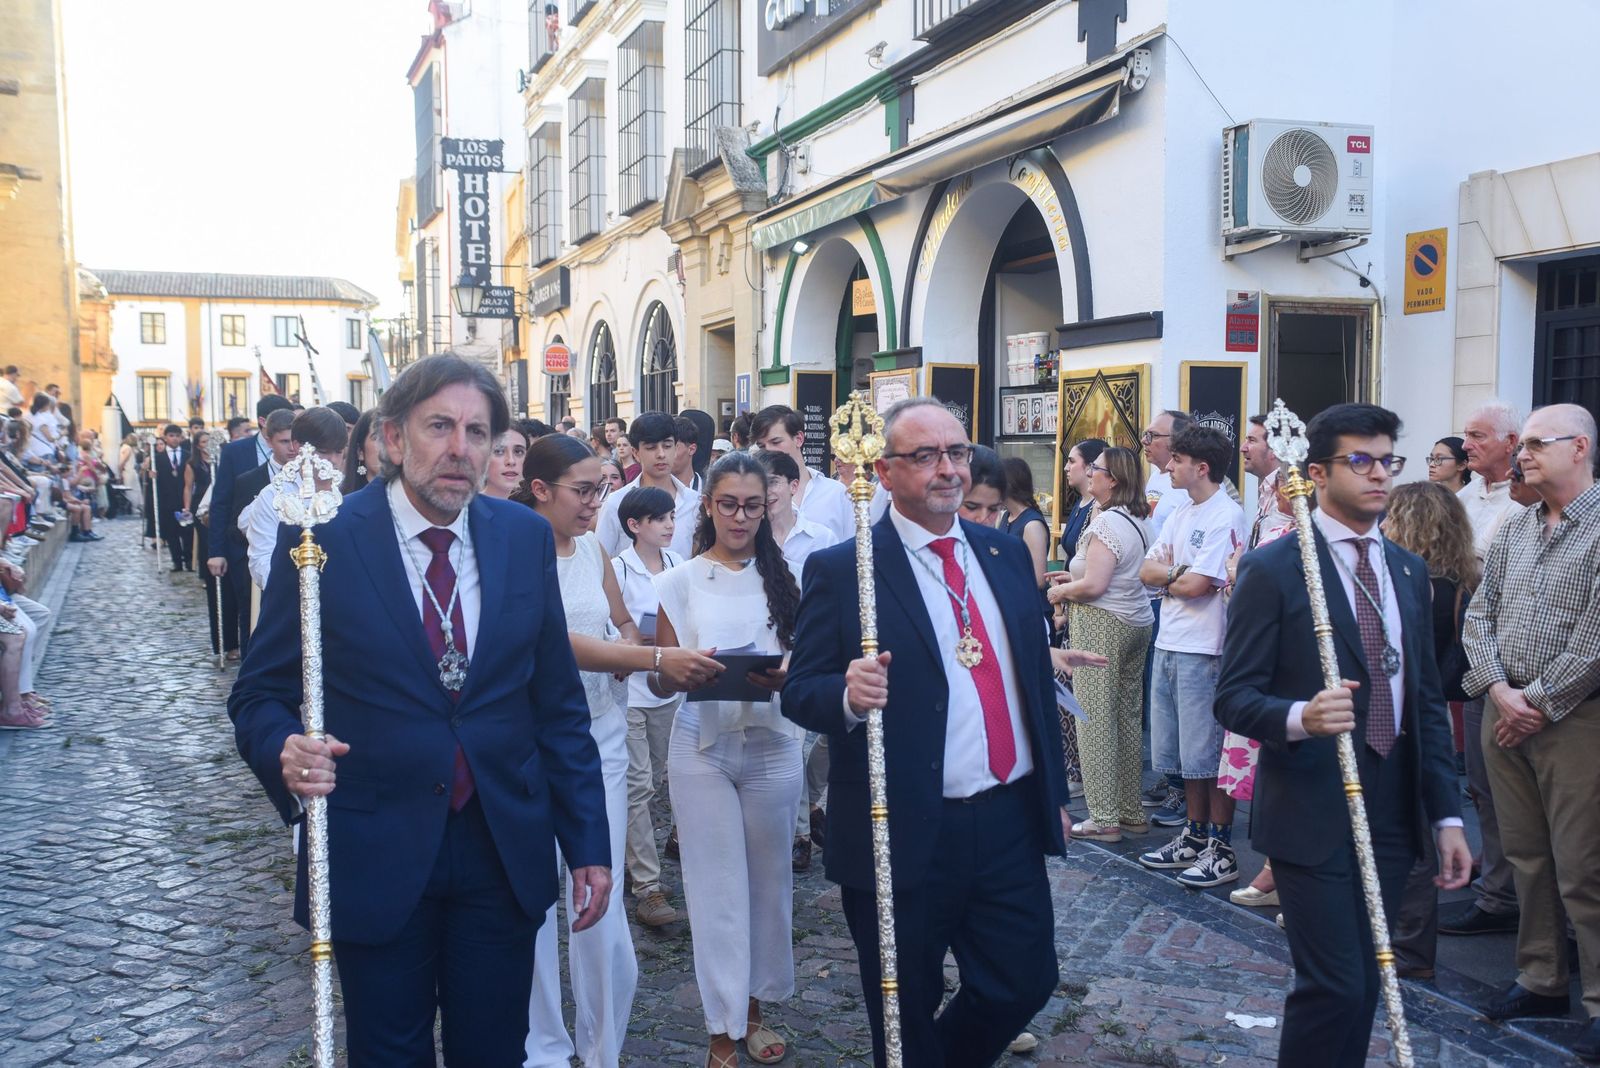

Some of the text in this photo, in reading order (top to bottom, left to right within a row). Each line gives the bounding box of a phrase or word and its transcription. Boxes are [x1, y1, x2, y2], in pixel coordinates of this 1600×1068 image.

[458, 141, 488, 154] LOS
[1350, 140, 1368, 149] TCL
[445, 153, 501, 167] PATIOS
[1416, 287, 1433, 296] VADO
[1406, 297, 1442, 308] PERMANENTE
[480, 306, 508, 315] OFTOP
[1229, 316, 1257, 325] Alarma
[545, 360, 569, 368] KING
